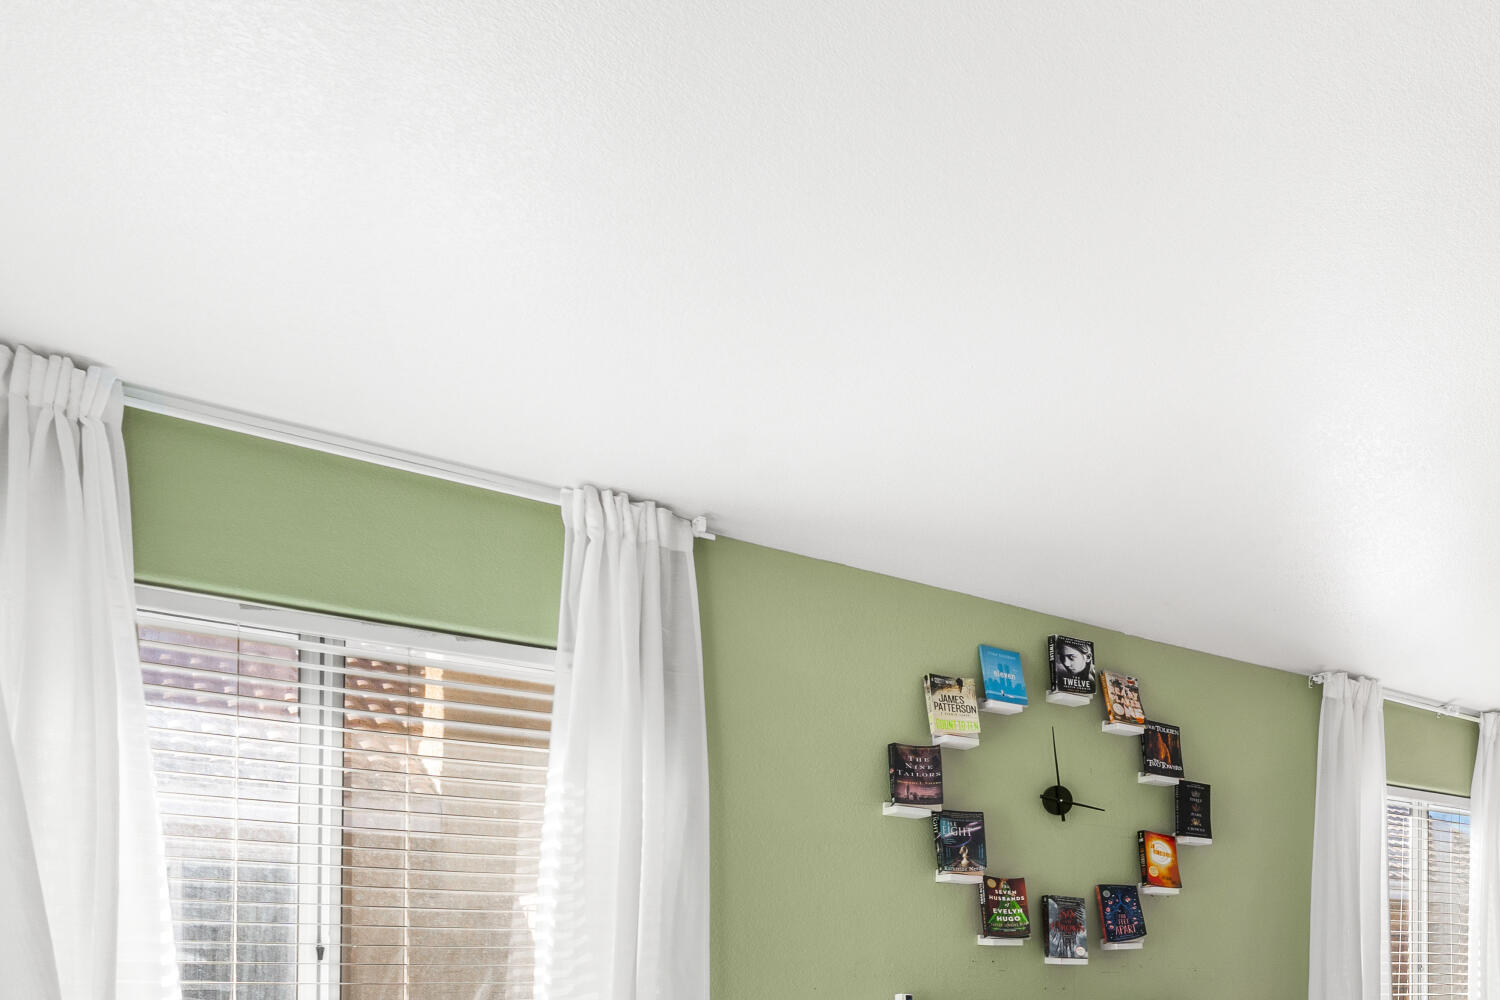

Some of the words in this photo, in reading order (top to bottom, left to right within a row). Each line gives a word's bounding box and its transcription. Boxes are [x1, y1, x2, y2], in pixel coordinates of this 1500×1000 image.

[993, 671, 1016, 680] eleven
[1064, 678, 1090, 688] TWELVE
[939, 694, 964, 704] JAMES
[934, 702, 977, 714] PATTERSON
[936, 718, 956, 730] COUNT
[958, 720, 967, 730] TO
[1116, 924, 1137, 936] APART
